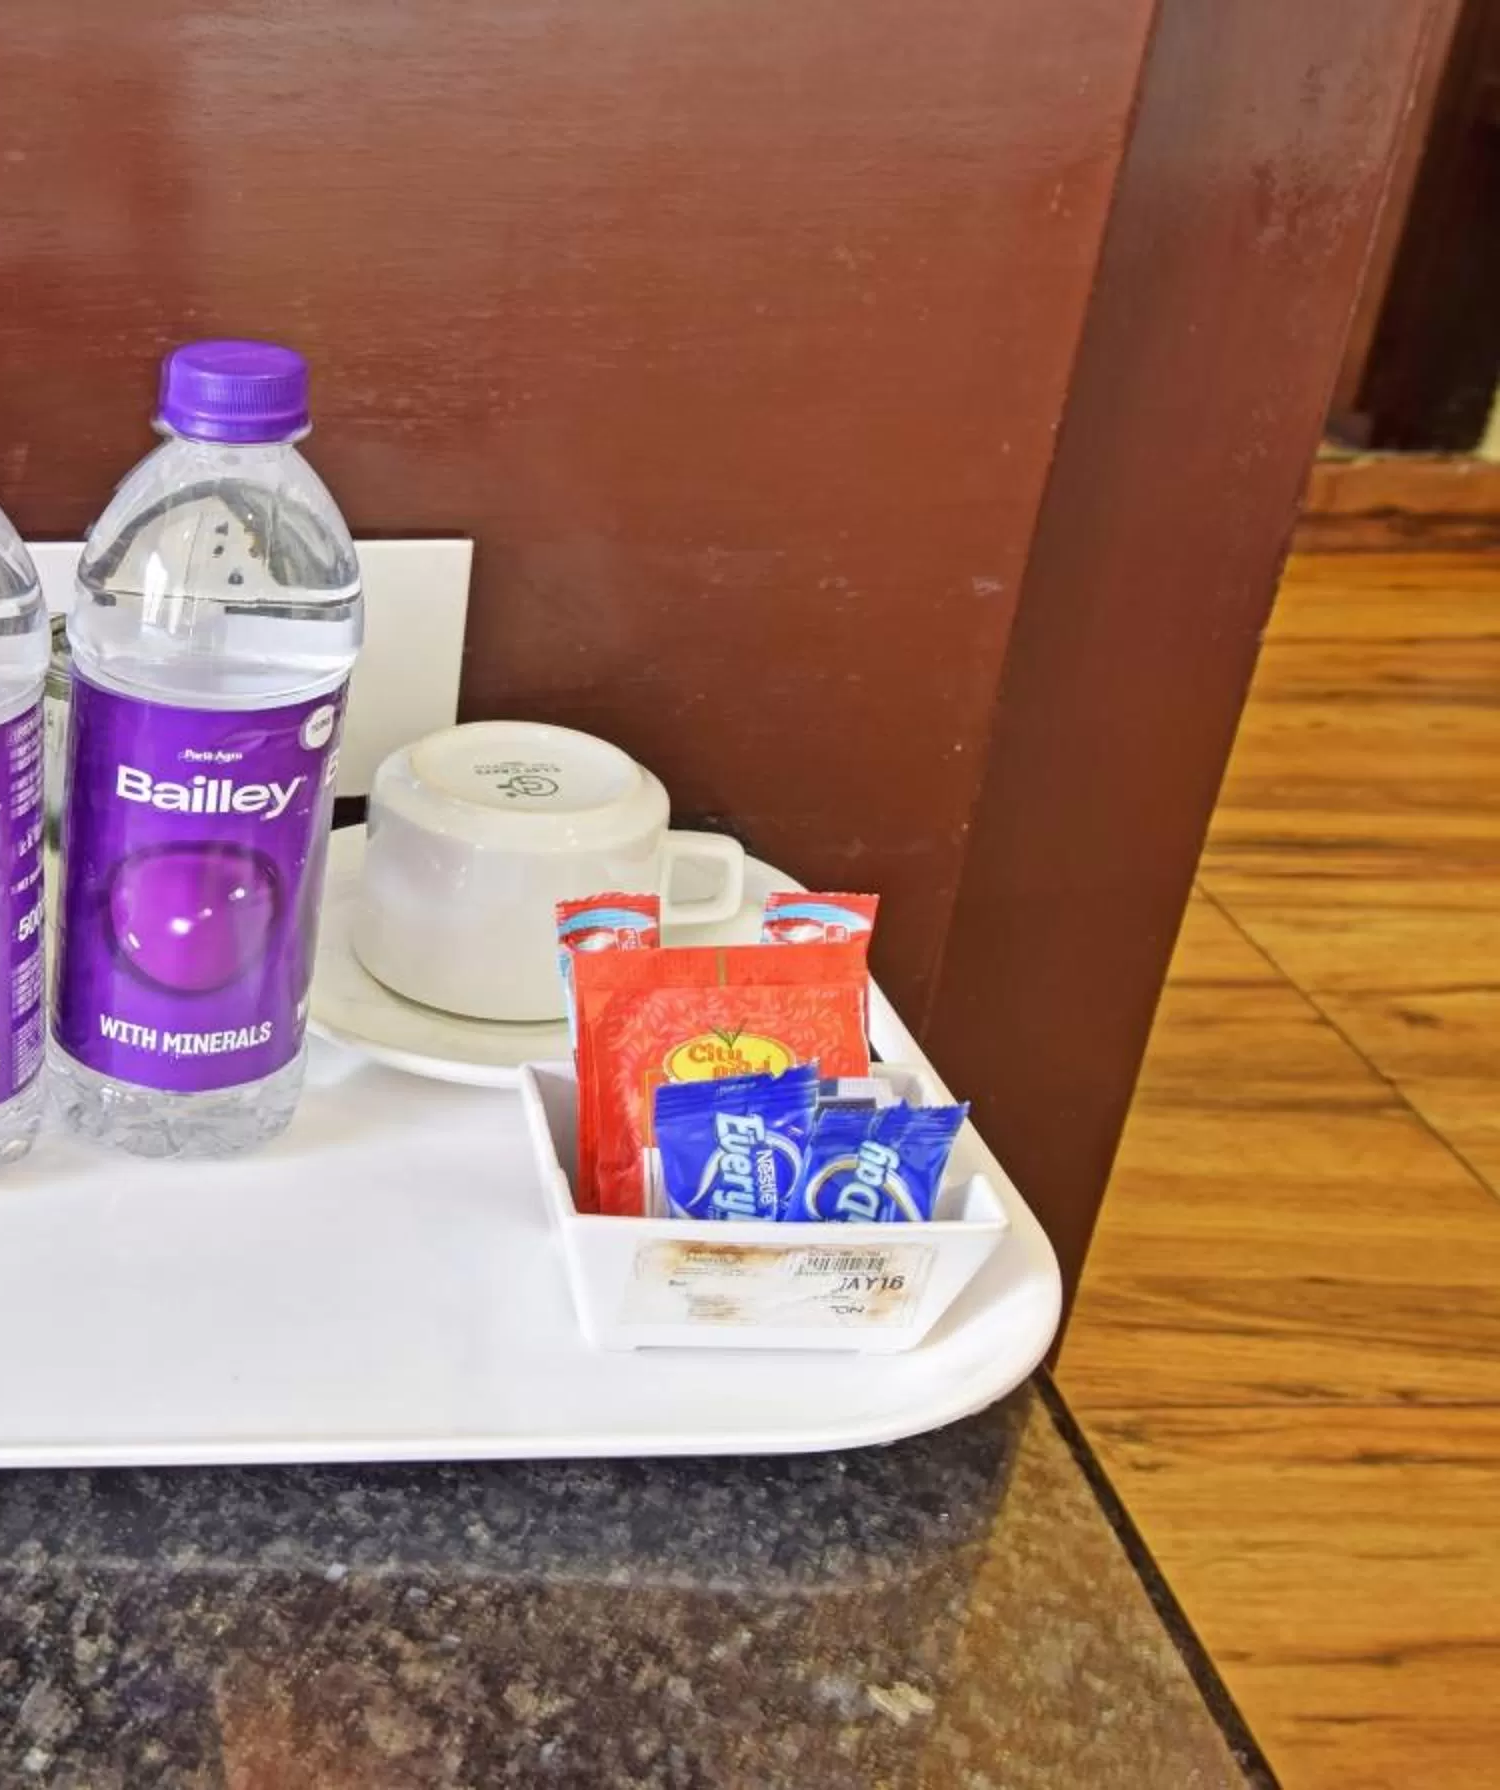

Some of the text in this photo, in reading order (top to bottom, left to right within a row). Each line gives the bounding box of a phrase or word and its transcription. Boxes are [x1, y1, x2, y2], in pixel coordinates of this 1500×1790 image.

[115, 764, 308, 820] Bailley
[100, 1013, 273, 1055] WITH MINERALS
[712, 1110, 765, 1220] Every
[836, 1139, 899, 1220] Day
